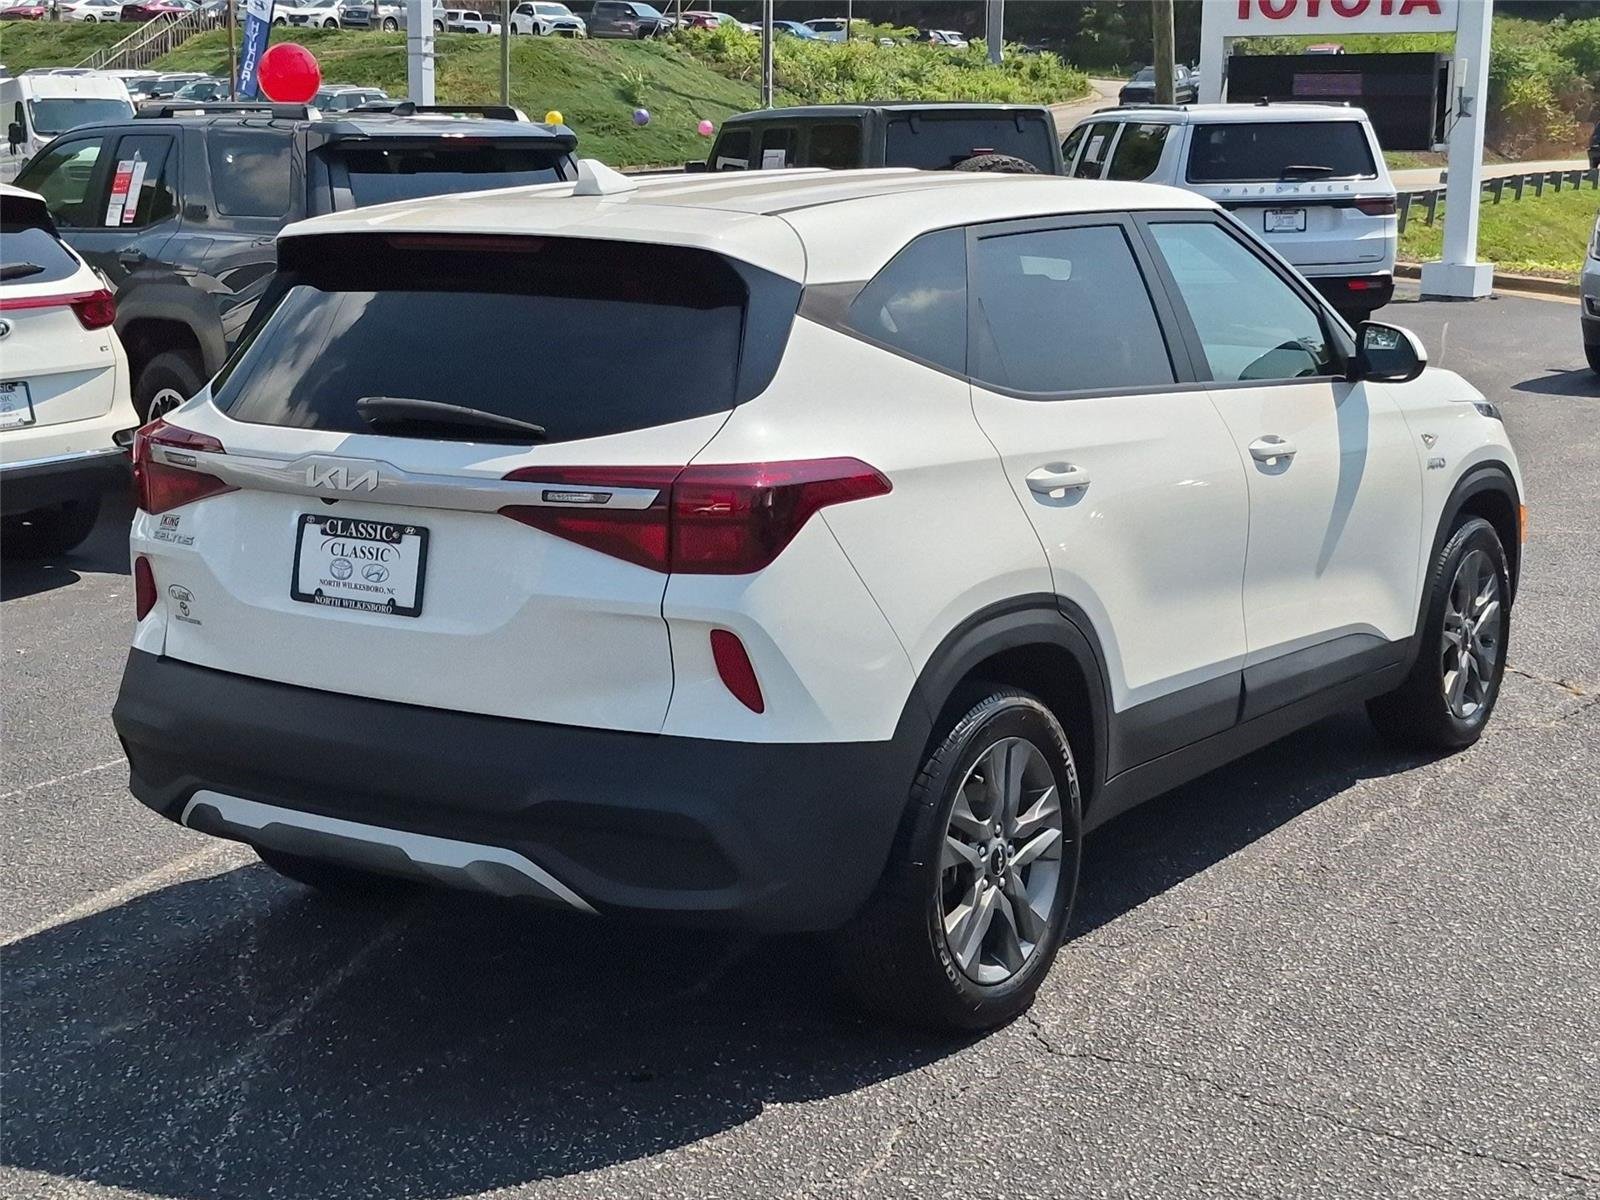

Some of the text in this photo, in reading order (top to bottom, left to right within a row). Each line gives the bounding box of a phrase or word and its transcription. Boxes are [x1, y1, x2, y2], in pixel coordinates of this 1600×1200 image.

[241, 21, 260, 90] HYUNDAI
[306, 464, 379, 492] KIA
[153, 531, 195, 545] SELTOS
[325, 519, 395, 541] CLASSIC
[330, 542, 391, 562] CLASSIC
[319, 578, 341, 589] NORTH
[386, 585, 396, 595] NC
[314, 596, 392, 614] NORTH WILKESBORO
